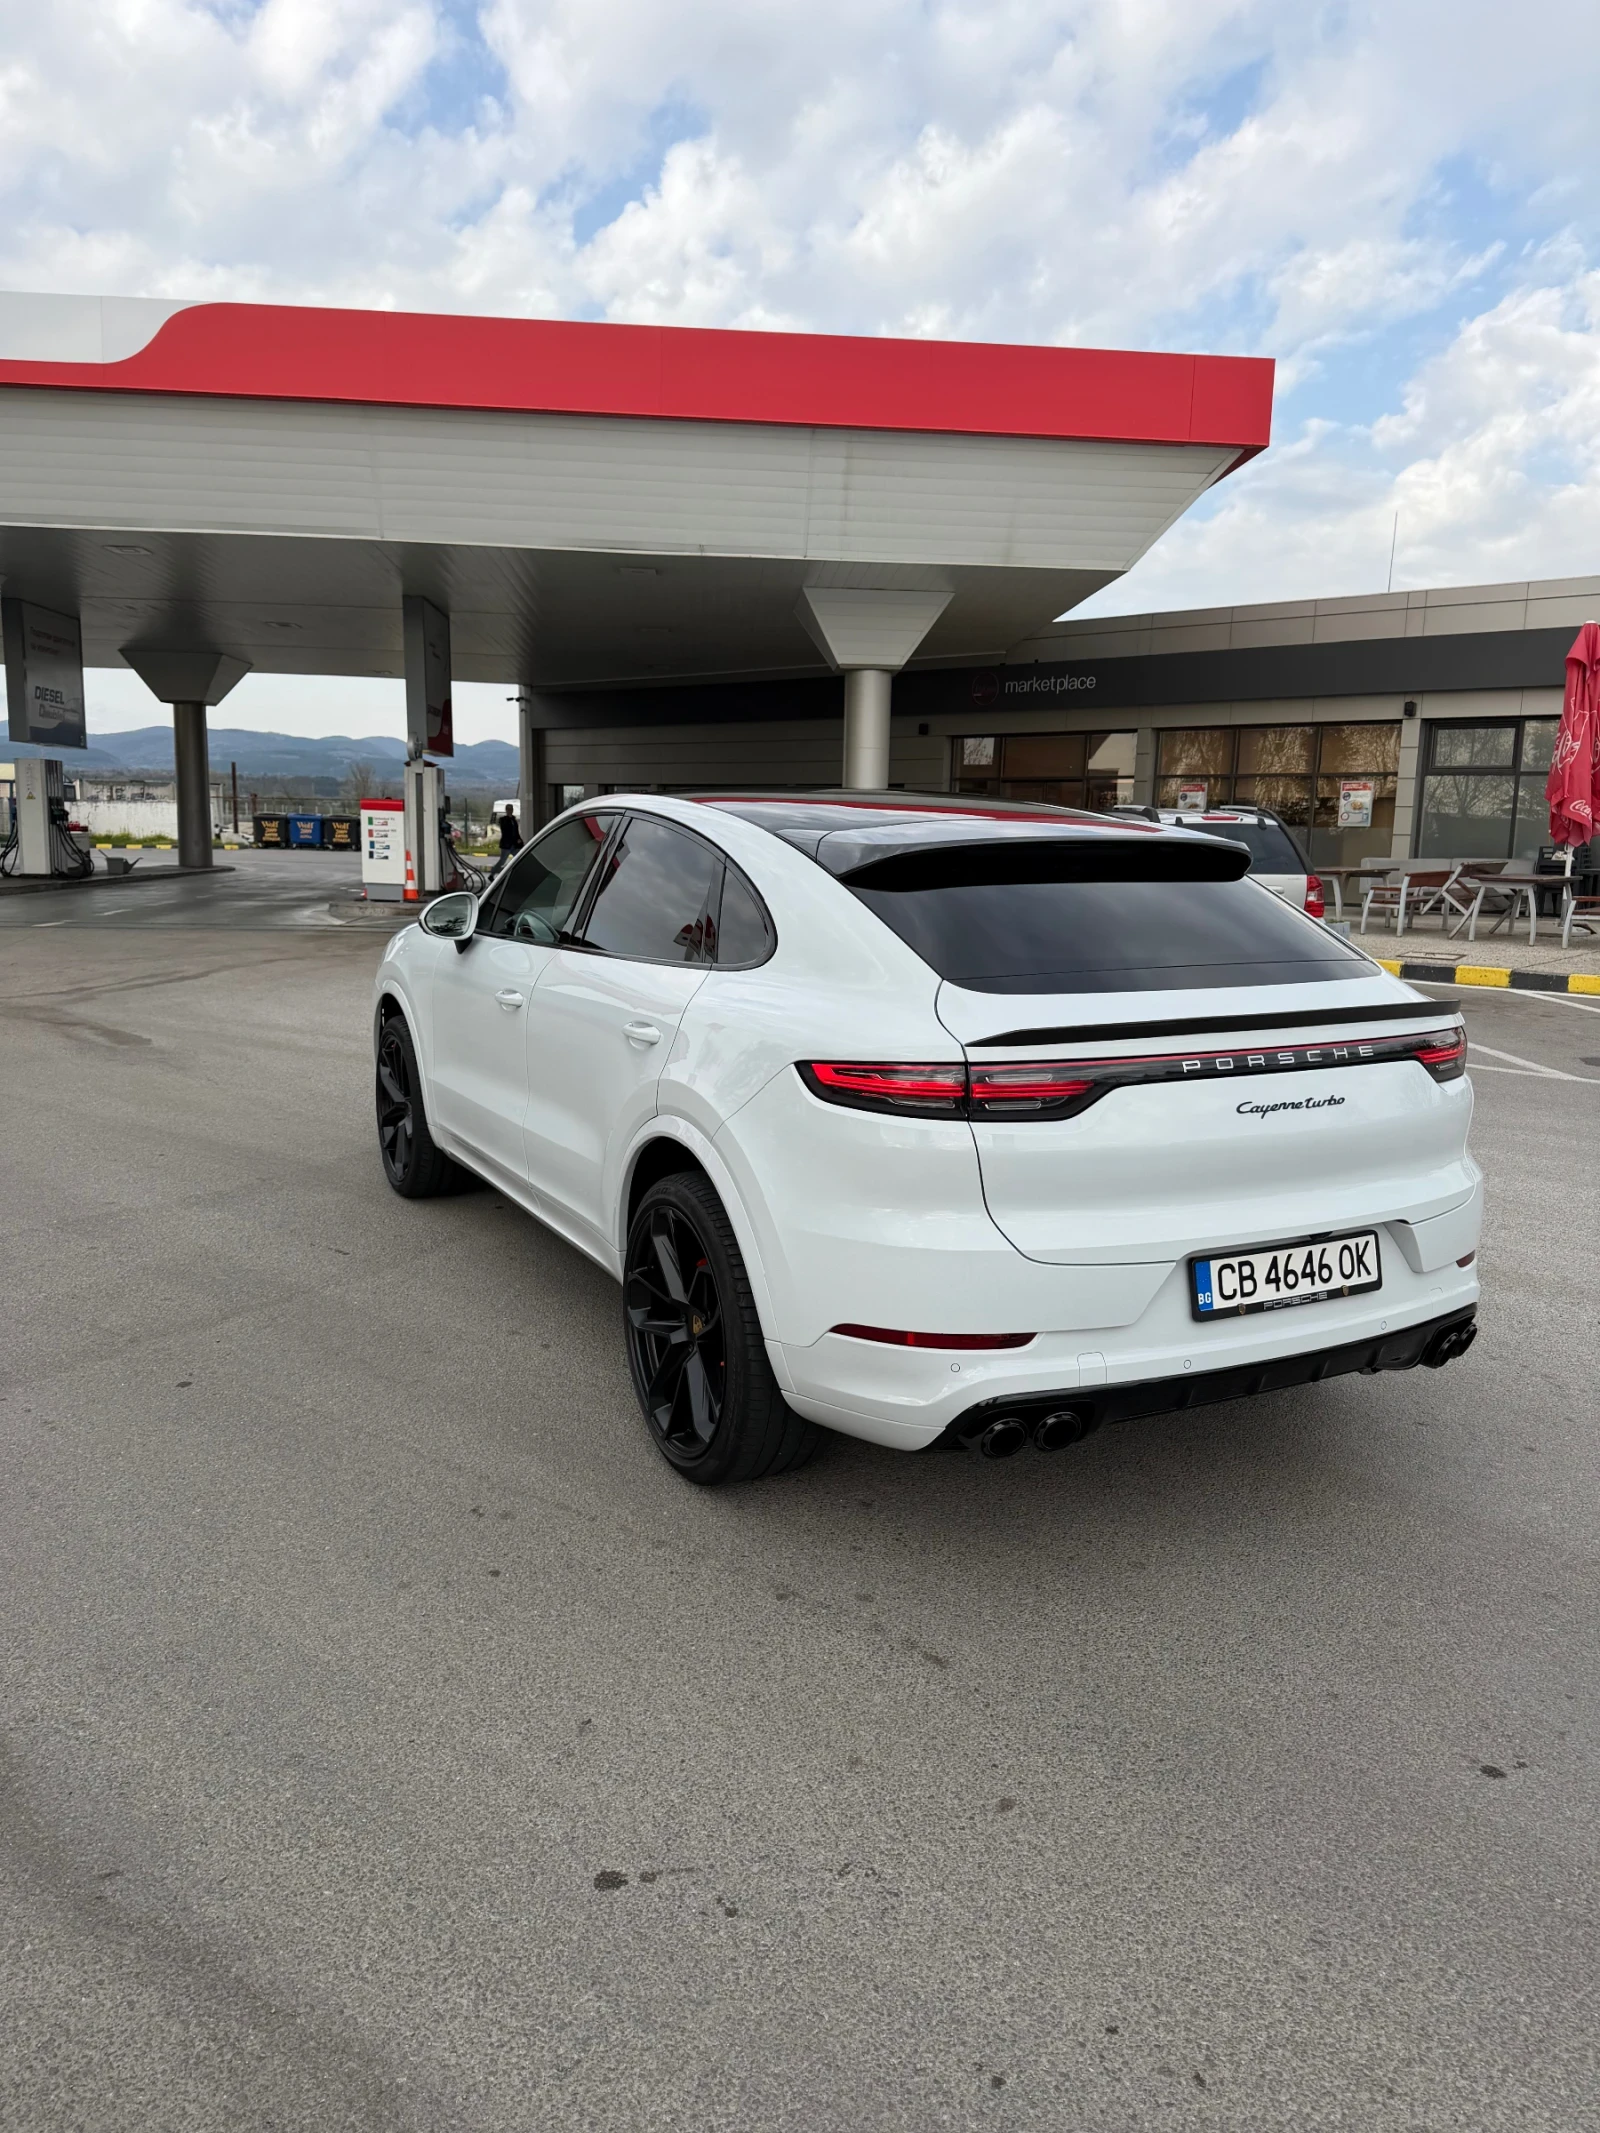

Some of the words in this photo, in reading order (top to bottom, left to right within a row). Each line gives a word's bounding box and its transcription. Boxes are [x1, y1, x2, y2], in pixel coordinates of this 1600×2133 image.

[34, 685, 65, 705] DIESEL
[261, 820, 279, 828] Wolf
[296, 821, 315, 829] Wolf
[332, 822, 350, 830] Wolf
[1182, 1045, 1375, 1073] PORSCHE
[1217, 1260, 1258, 1301] CB
[1264, 1247, 1333, 1292] 4646
[1338, 1240, 1372, 1280] OK
[1197, 1292, 1212, 1305] BG
[1263, 1291, 1328, 1311] PORSCHE
